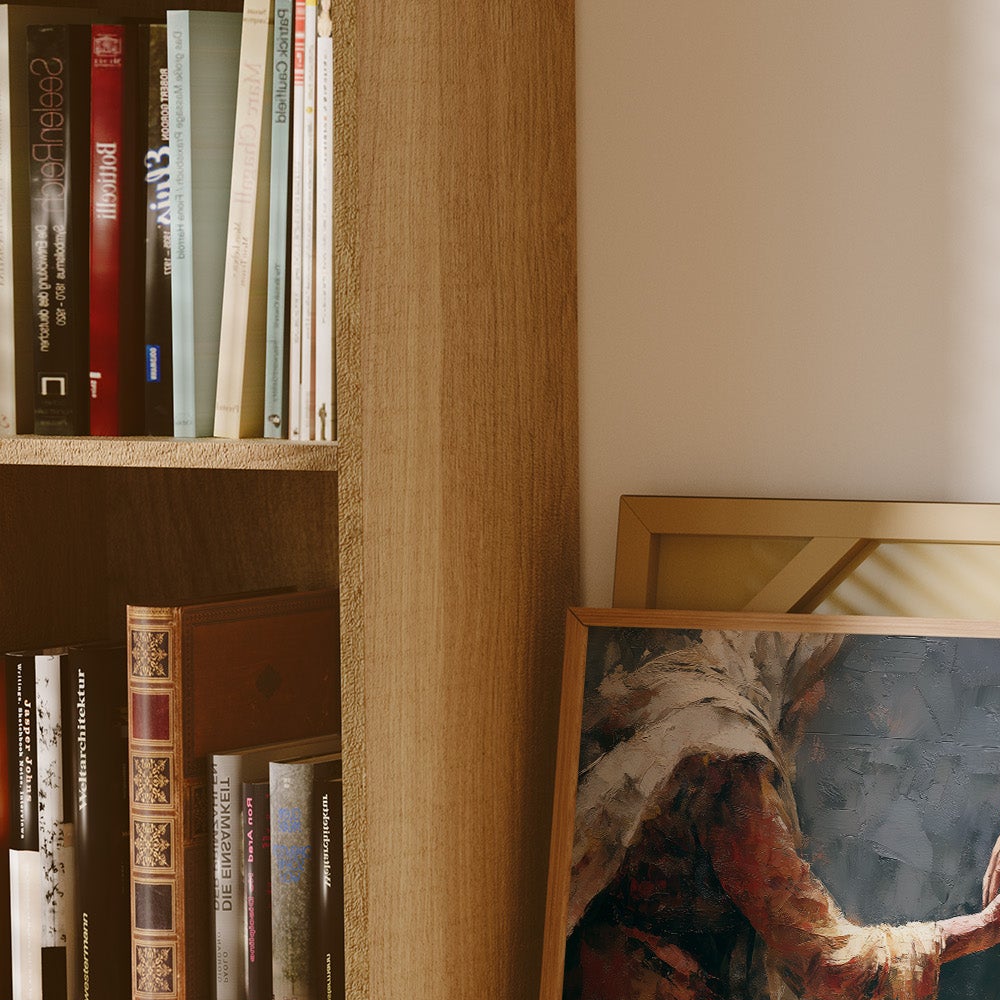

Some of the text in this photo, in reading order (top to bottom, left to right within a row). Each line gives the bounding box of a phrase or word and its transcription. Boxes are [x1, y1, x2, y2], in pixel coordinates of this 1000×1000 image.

[23, 700, 33, 802] Jasper Johns
[77, 669, 88, 810] Weltarchitektur
